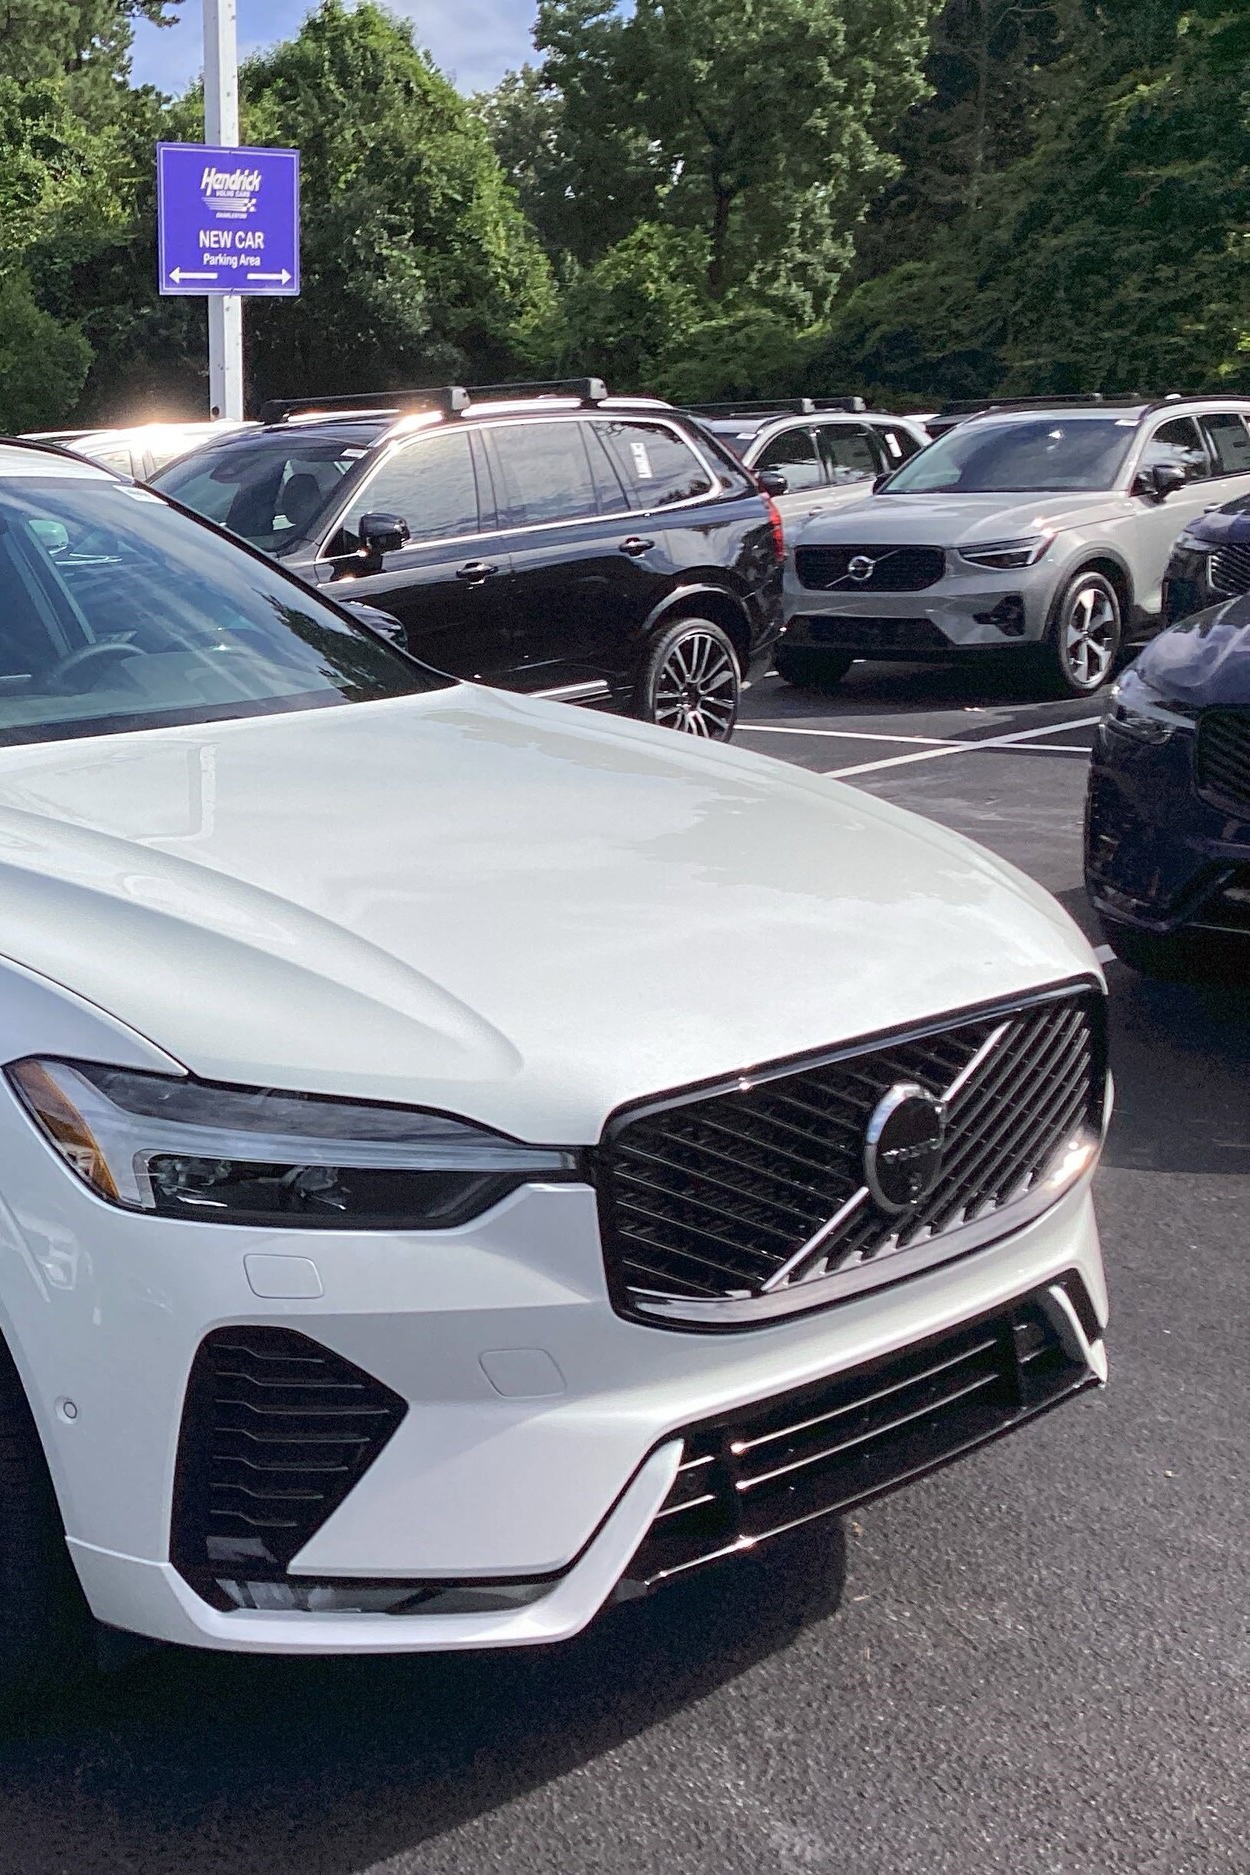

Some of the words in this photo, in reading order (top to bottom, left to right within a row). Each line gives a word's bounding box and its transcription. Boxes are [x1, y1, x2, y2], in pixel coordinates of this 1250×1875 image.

[200, 167, 262, 196] Hendrick
[199, 230, 233, 248] NEW
[235, 231, 264, 249] CAR
[203, 253, 238, 269] Parking
[239, 254, 261, 266] Area
